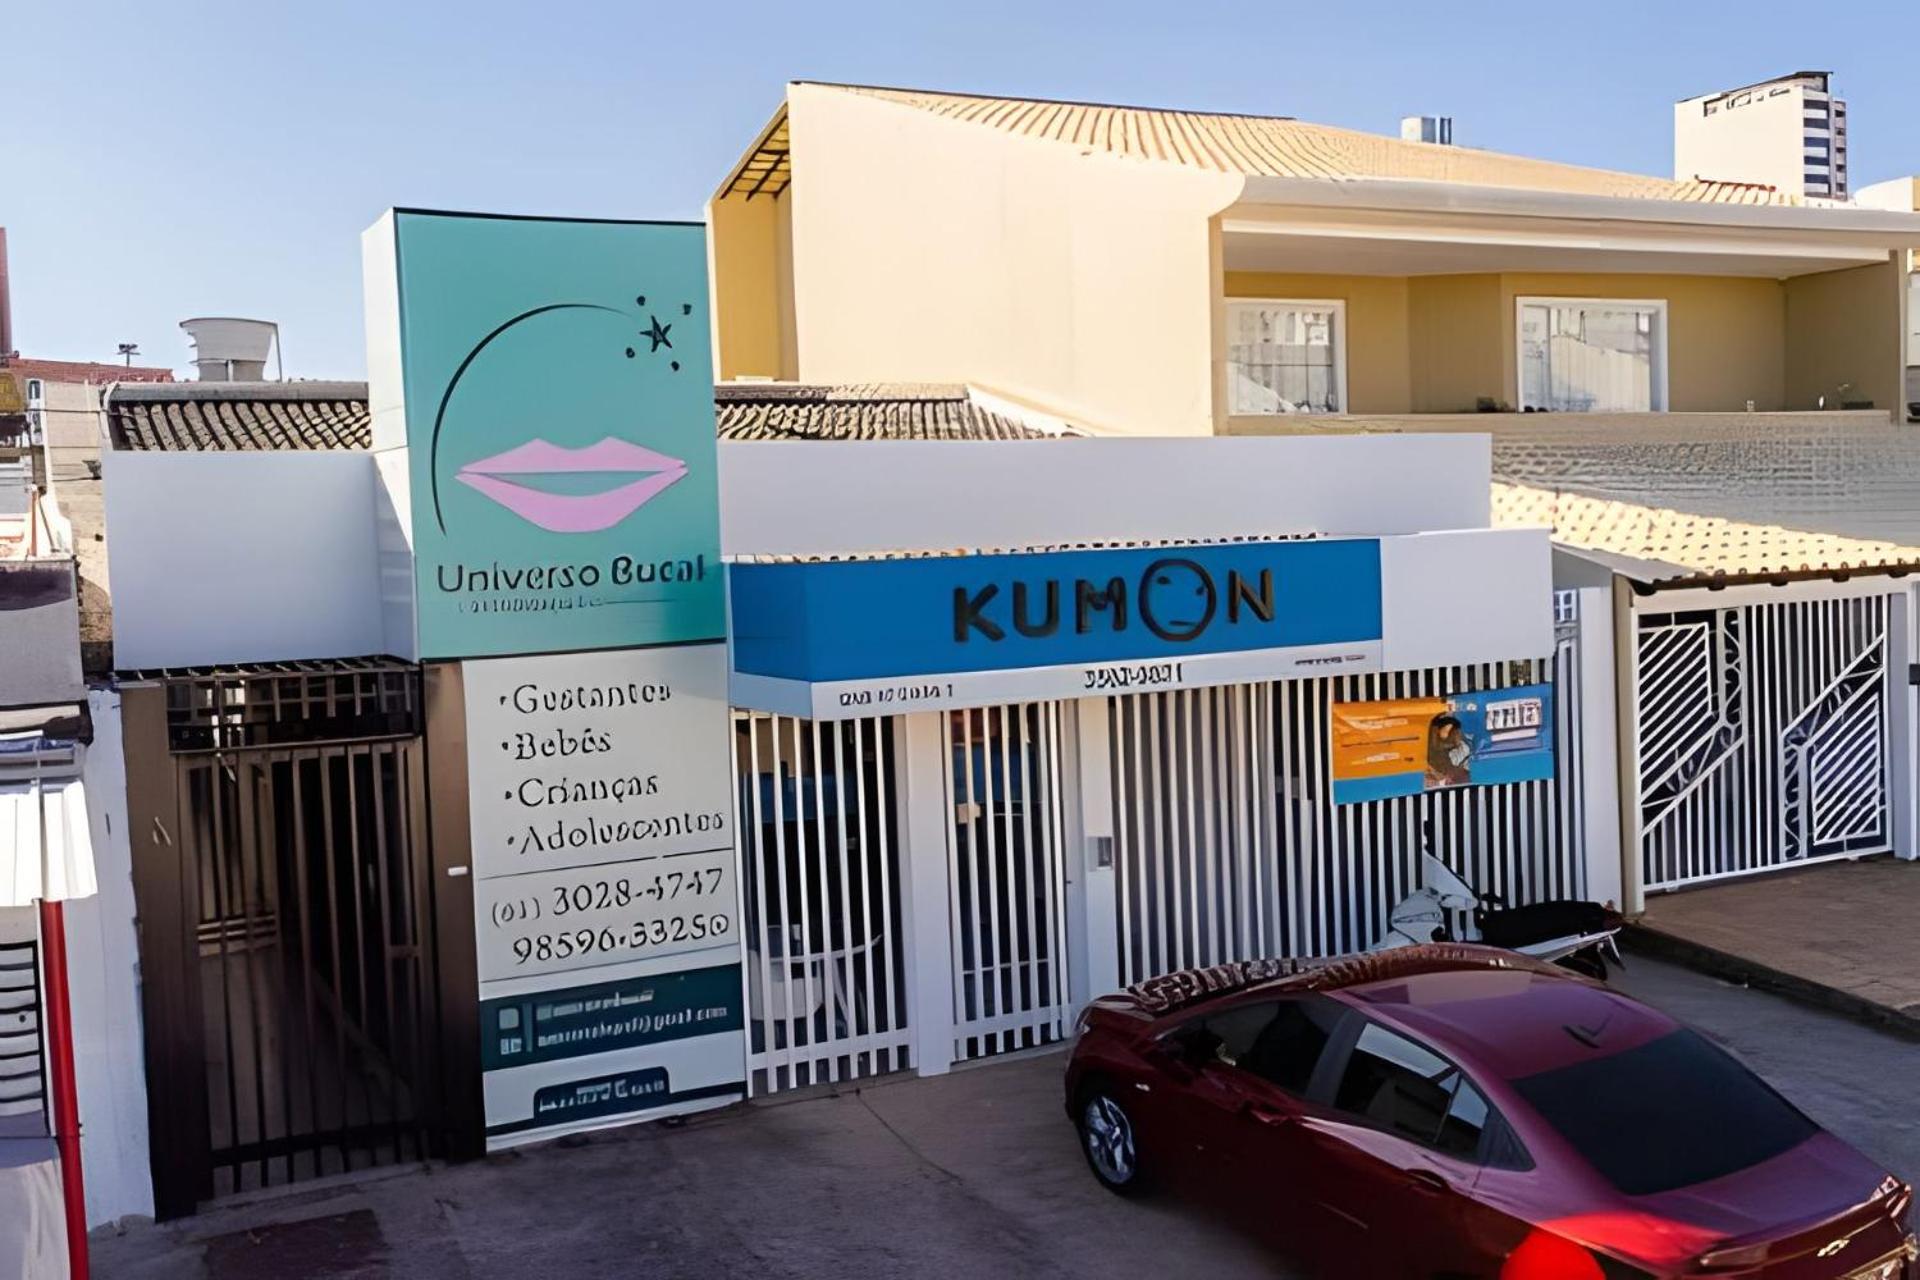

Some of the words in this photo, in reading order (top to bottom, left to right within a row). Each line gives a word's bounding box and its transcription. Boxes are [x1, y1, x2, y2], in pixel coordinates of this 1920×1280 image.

[437, 562, 601, 592] Universo
[611, 553, 705, 585] Bucal
[953, 558, 1276, 643] KUMON
